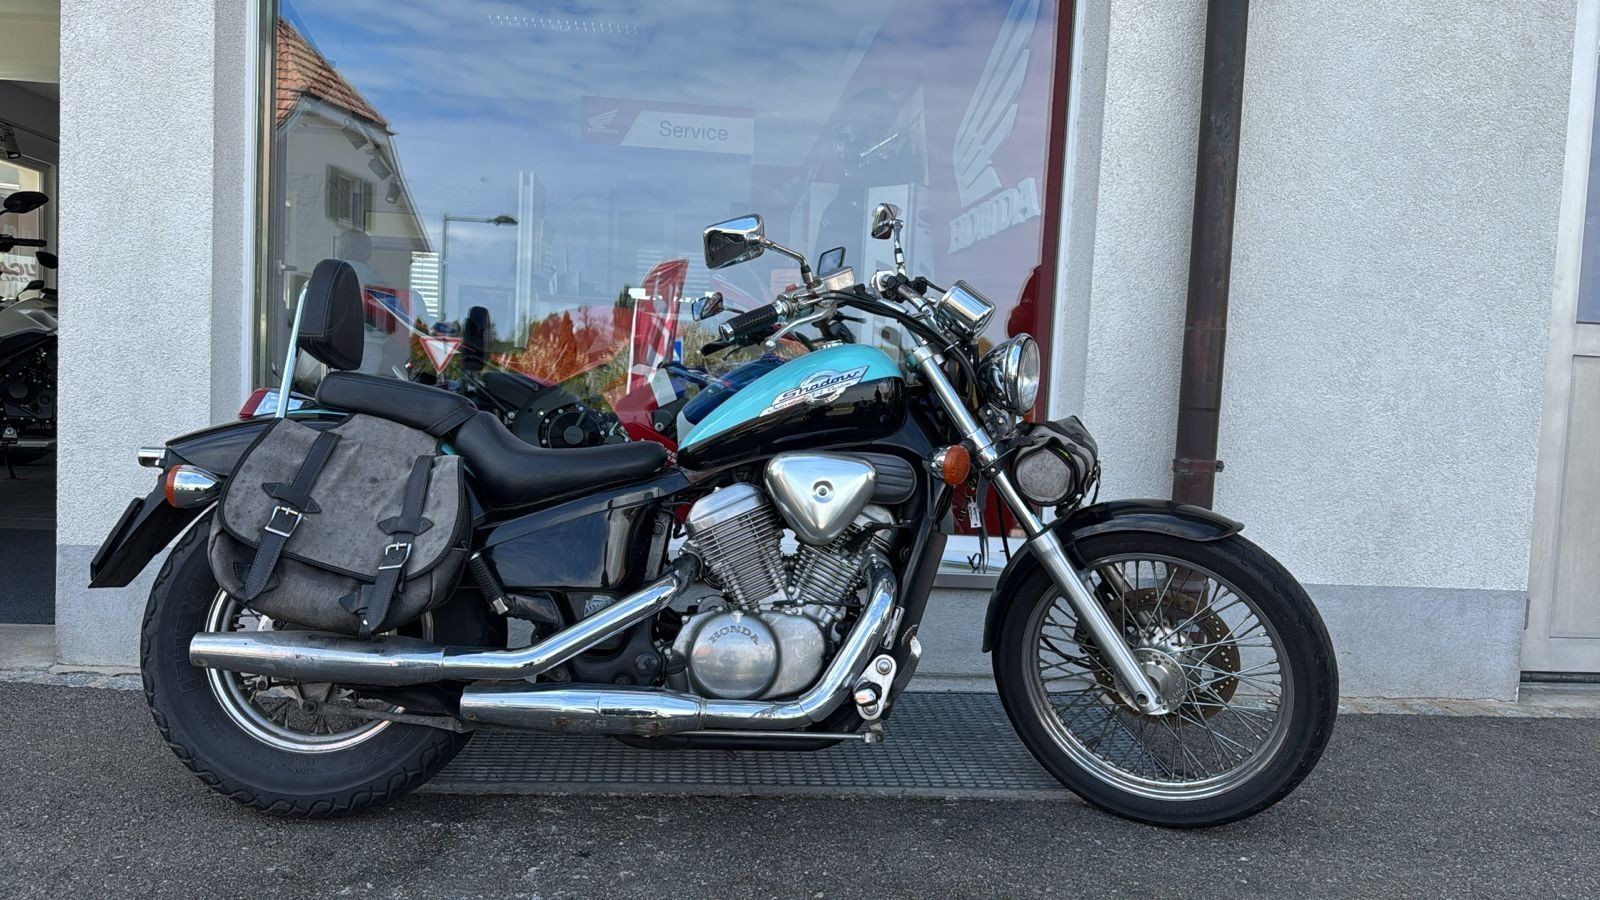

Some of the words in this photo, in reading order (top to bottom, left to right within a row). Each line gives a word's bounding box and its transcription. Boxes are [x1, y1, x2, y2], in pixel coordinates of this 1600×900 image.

[658, 120, 729, 141] Service
[947, 177, 1042, 254] HONDA
[779, 370, 861, 403] Shadow
[708, 625, 759, 646] HONDA
